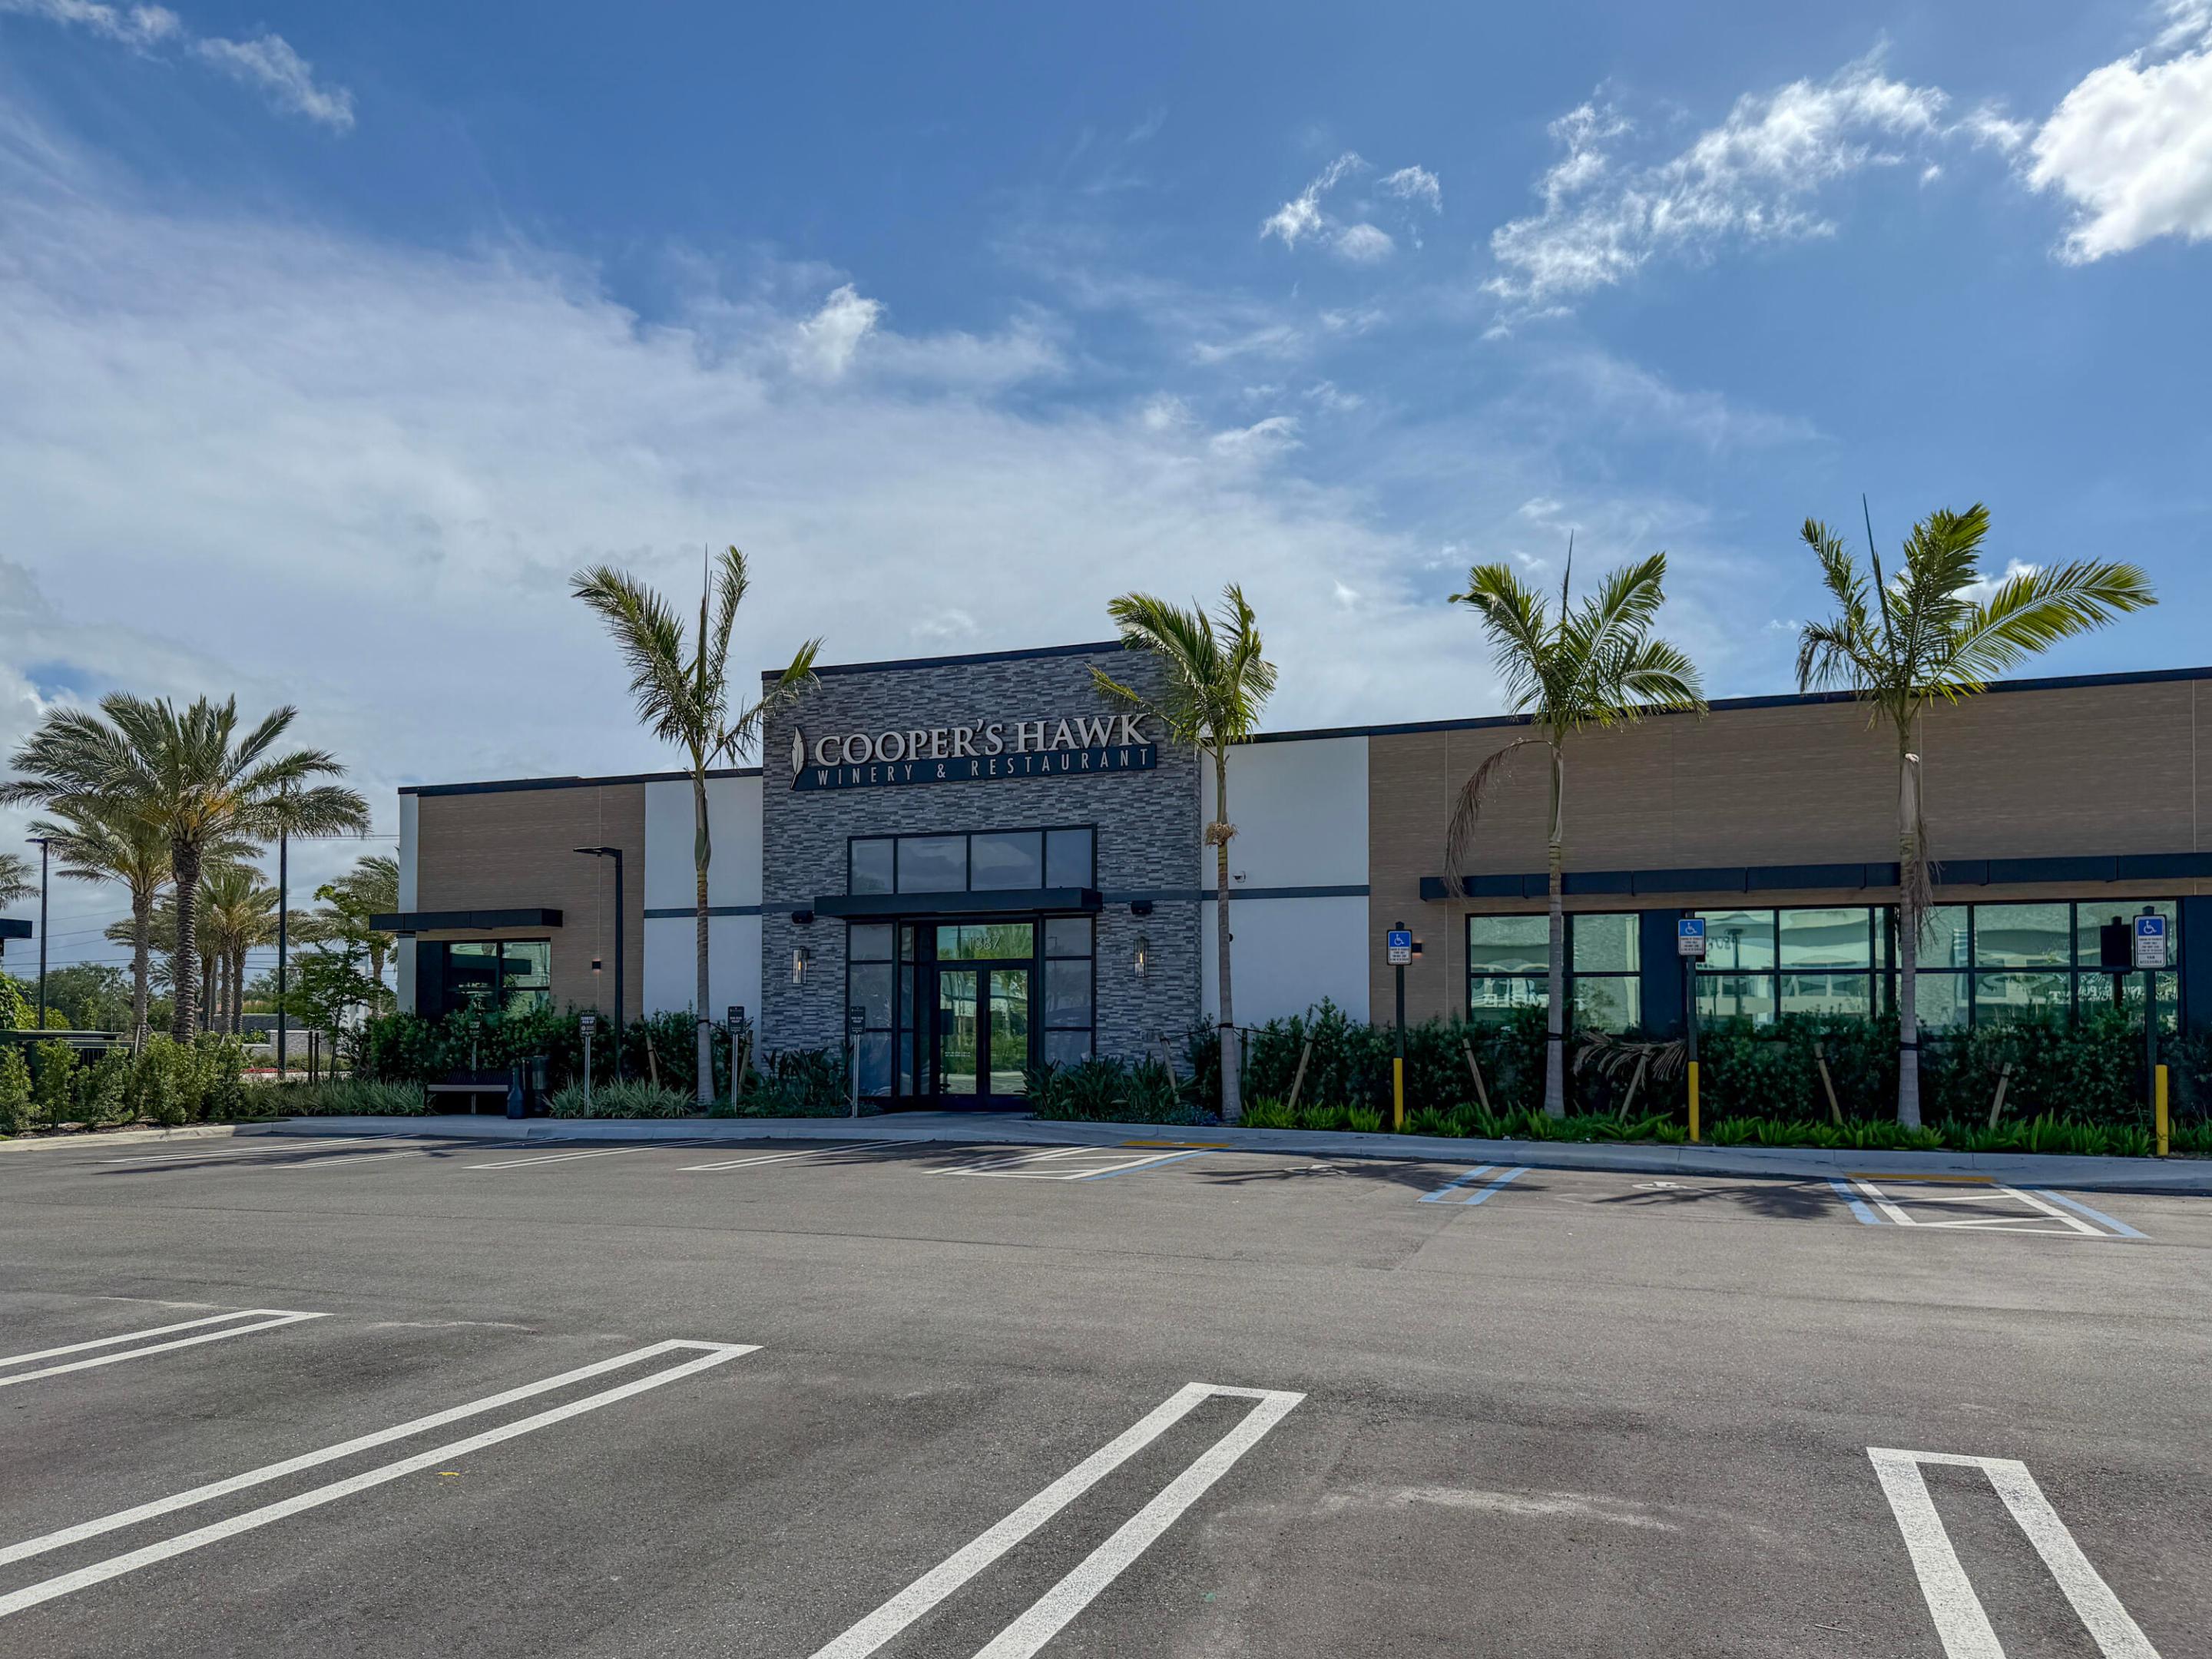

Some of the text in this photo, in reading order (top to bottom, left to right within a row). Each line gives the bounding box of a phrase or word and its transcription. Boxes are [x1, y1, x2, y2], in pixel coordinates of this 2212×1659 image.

[815, 712, 1151, 767] COOPER'S HAWK
[817, 748, 1148, 786] WINERY & RESTAURANT
[969, 935, 1002, 951] 1387
